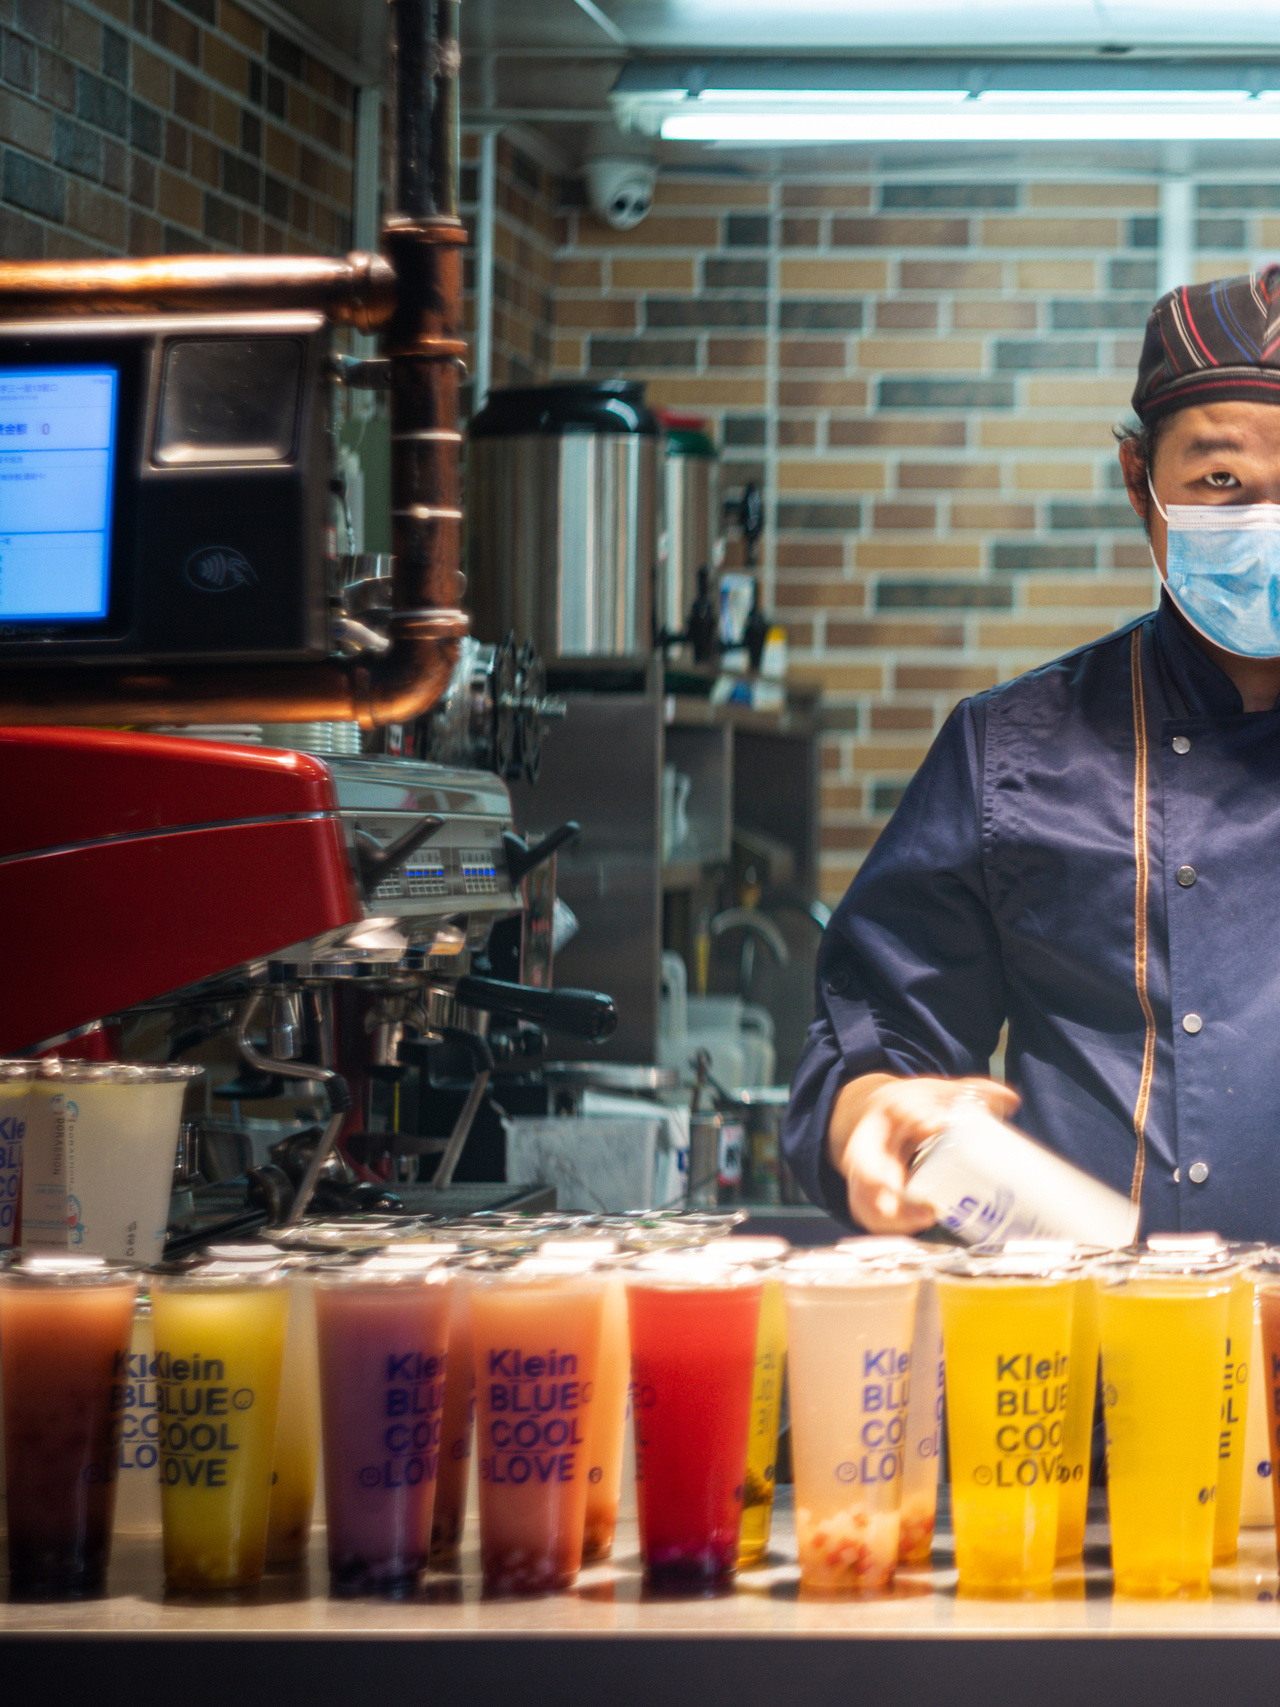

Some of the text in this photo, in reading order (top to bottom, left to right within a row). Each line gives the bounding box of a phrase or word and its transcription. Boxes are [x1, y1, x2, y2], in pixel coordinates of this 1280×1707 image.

[42, 423, 50, 436] 0
[489, 1348, 578, 1377] Klein
[490, 1382, 580, 1412] BLUE
[491, 1418, 584, 1448] COOL
[492, 1453, 576, 1483] LOVE
